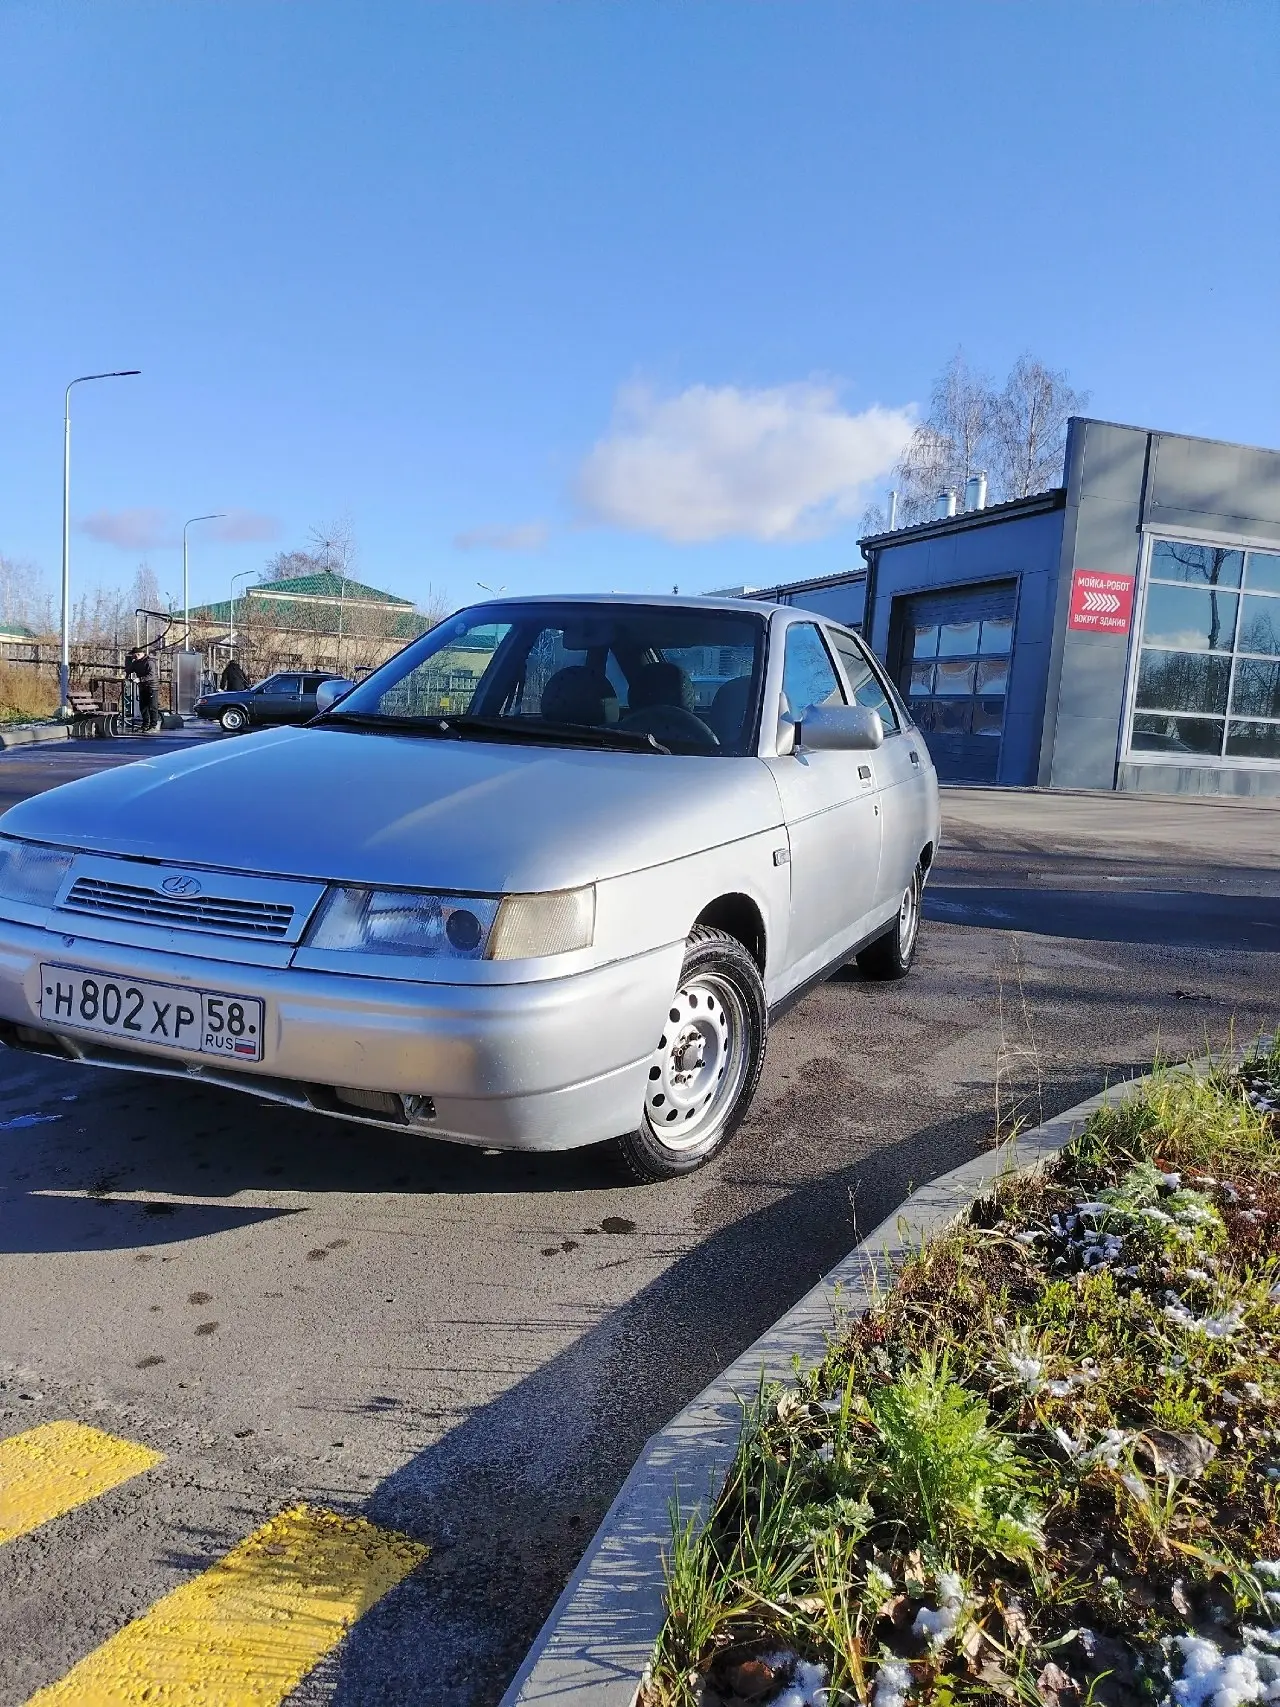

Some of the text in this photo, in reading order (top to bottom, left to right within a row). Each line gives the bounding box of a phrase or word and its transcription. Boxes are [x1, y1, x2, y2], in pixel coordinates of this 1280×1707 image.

[1078, 577, 1130, 591] МОЙКА-РОБОТ
[1074, 614, 1126, 627] ВОКРУГ ЗДАНИЯ
[207, 999, 245, 1035] 58
[205, 1034, 233, 1050] RUS
